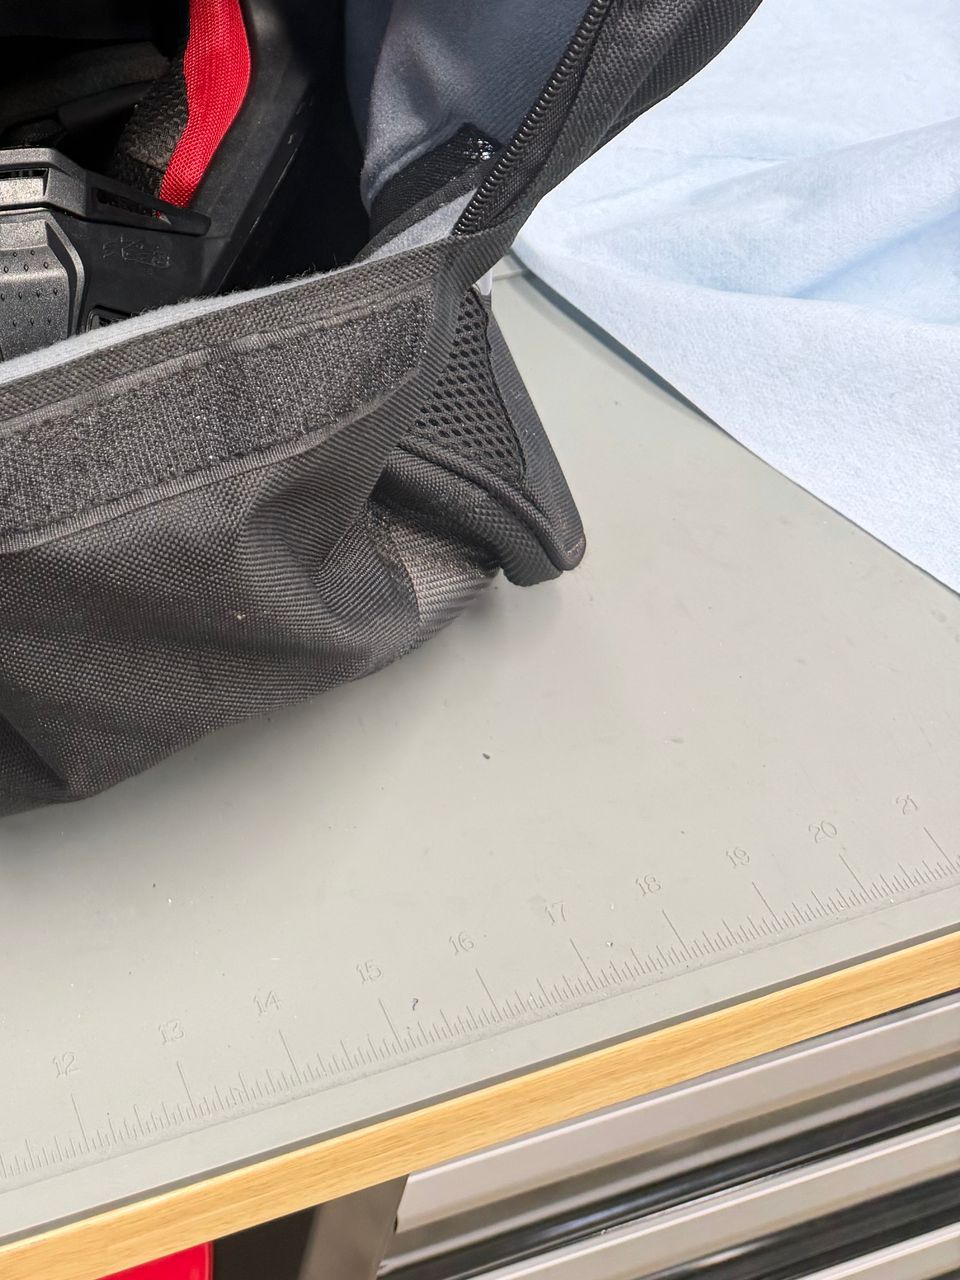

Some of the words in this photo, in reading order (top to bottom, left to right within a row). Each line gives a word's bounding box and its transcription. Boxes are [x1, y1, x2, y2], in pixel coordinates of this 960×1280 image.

[52, 1051, 81, 1078] 12
[158, 1019, 185, 1046] 13
[252, 992, 282, 1017] 14
[355, 960, 383, 985] 15
[448, 931, 475, 956] 16
[544, 900, 568, 926] 17
[635, 873, 663, 898] 18
[725, 846, 752, 871] 19
[808, 819, 839, 845] 20
[895, 793, 920, 815] 21
